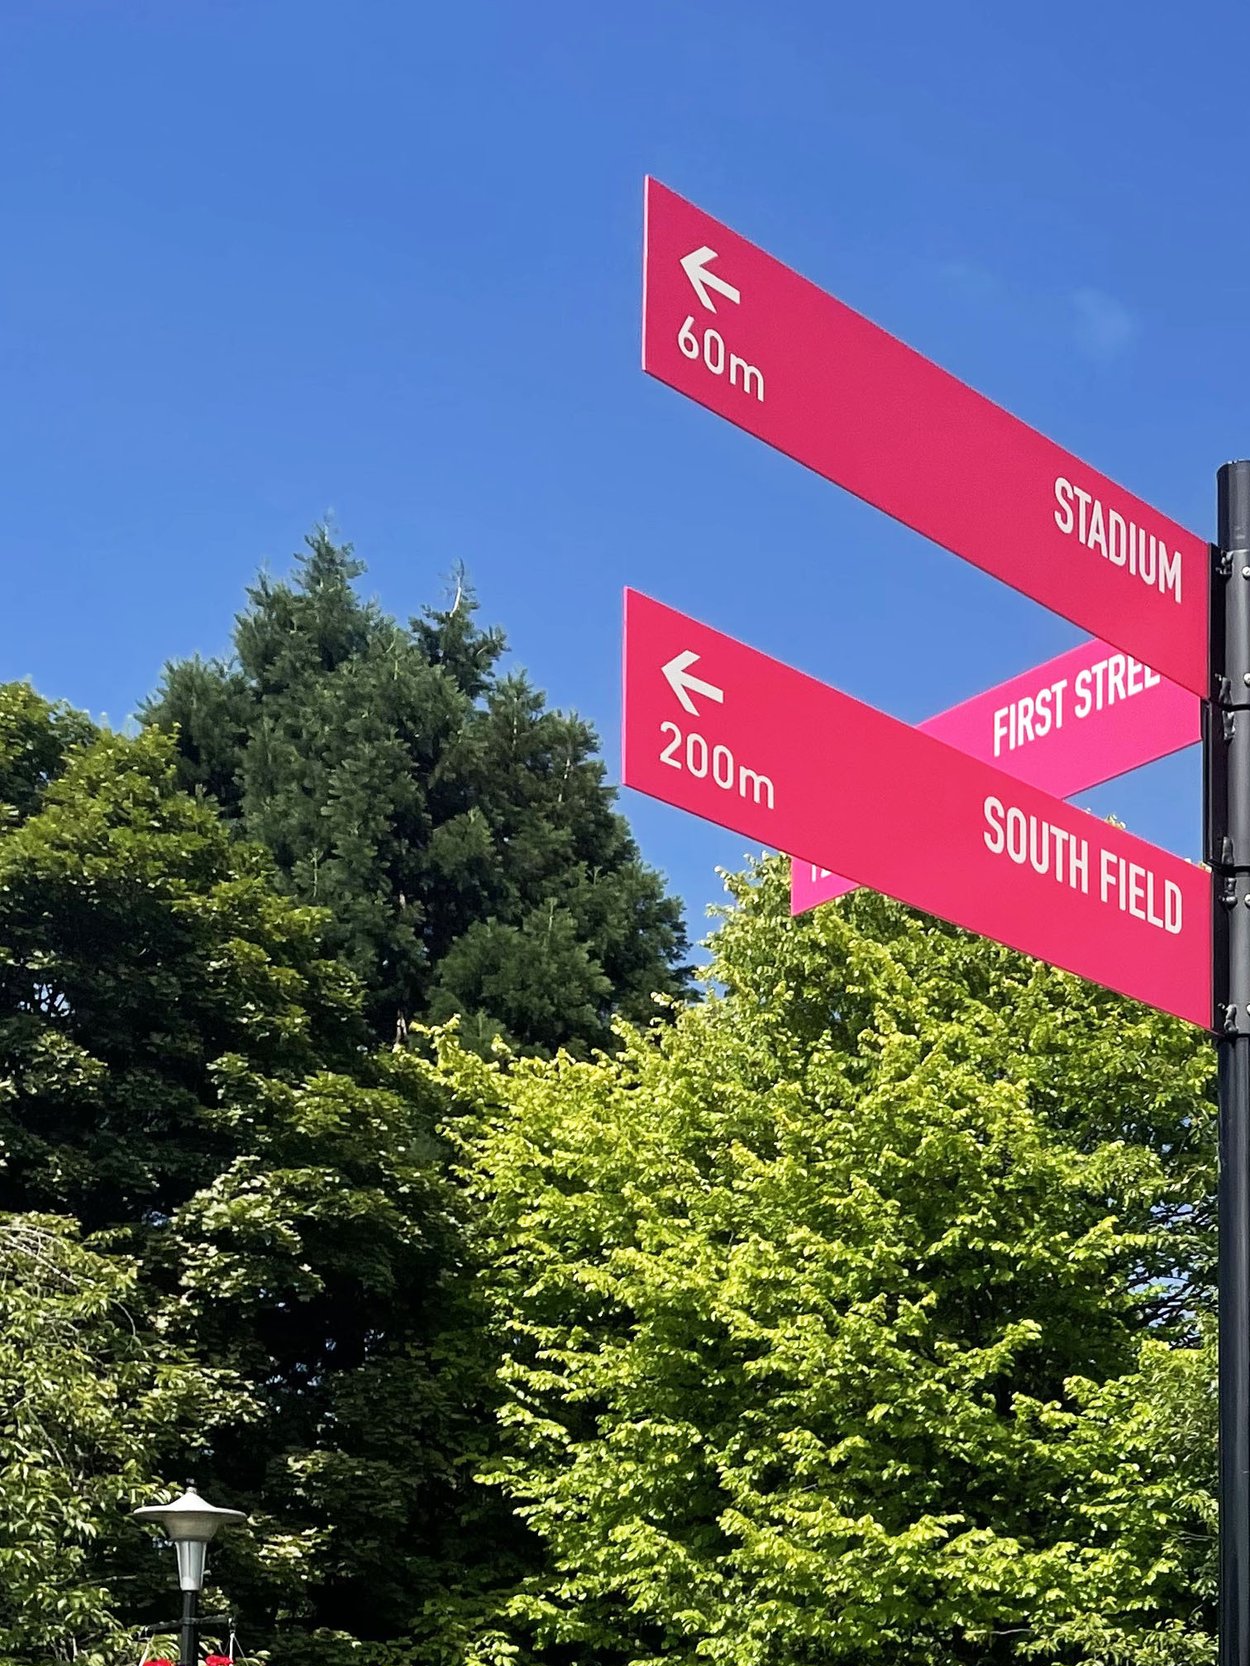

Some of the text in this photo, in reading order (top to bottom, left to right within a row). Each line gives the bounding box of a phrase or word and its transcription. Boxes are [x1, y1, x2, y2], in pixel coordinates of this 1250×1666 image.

[677, 315, 765, 402] 60m
[1053, 476, 1183, 604] STADIUM
[993, 653, 1161, 758] FIRST STRE
[659, 720, 775, 810] 200m
[982, 796, 1184, 935] SOUTH FIELD
